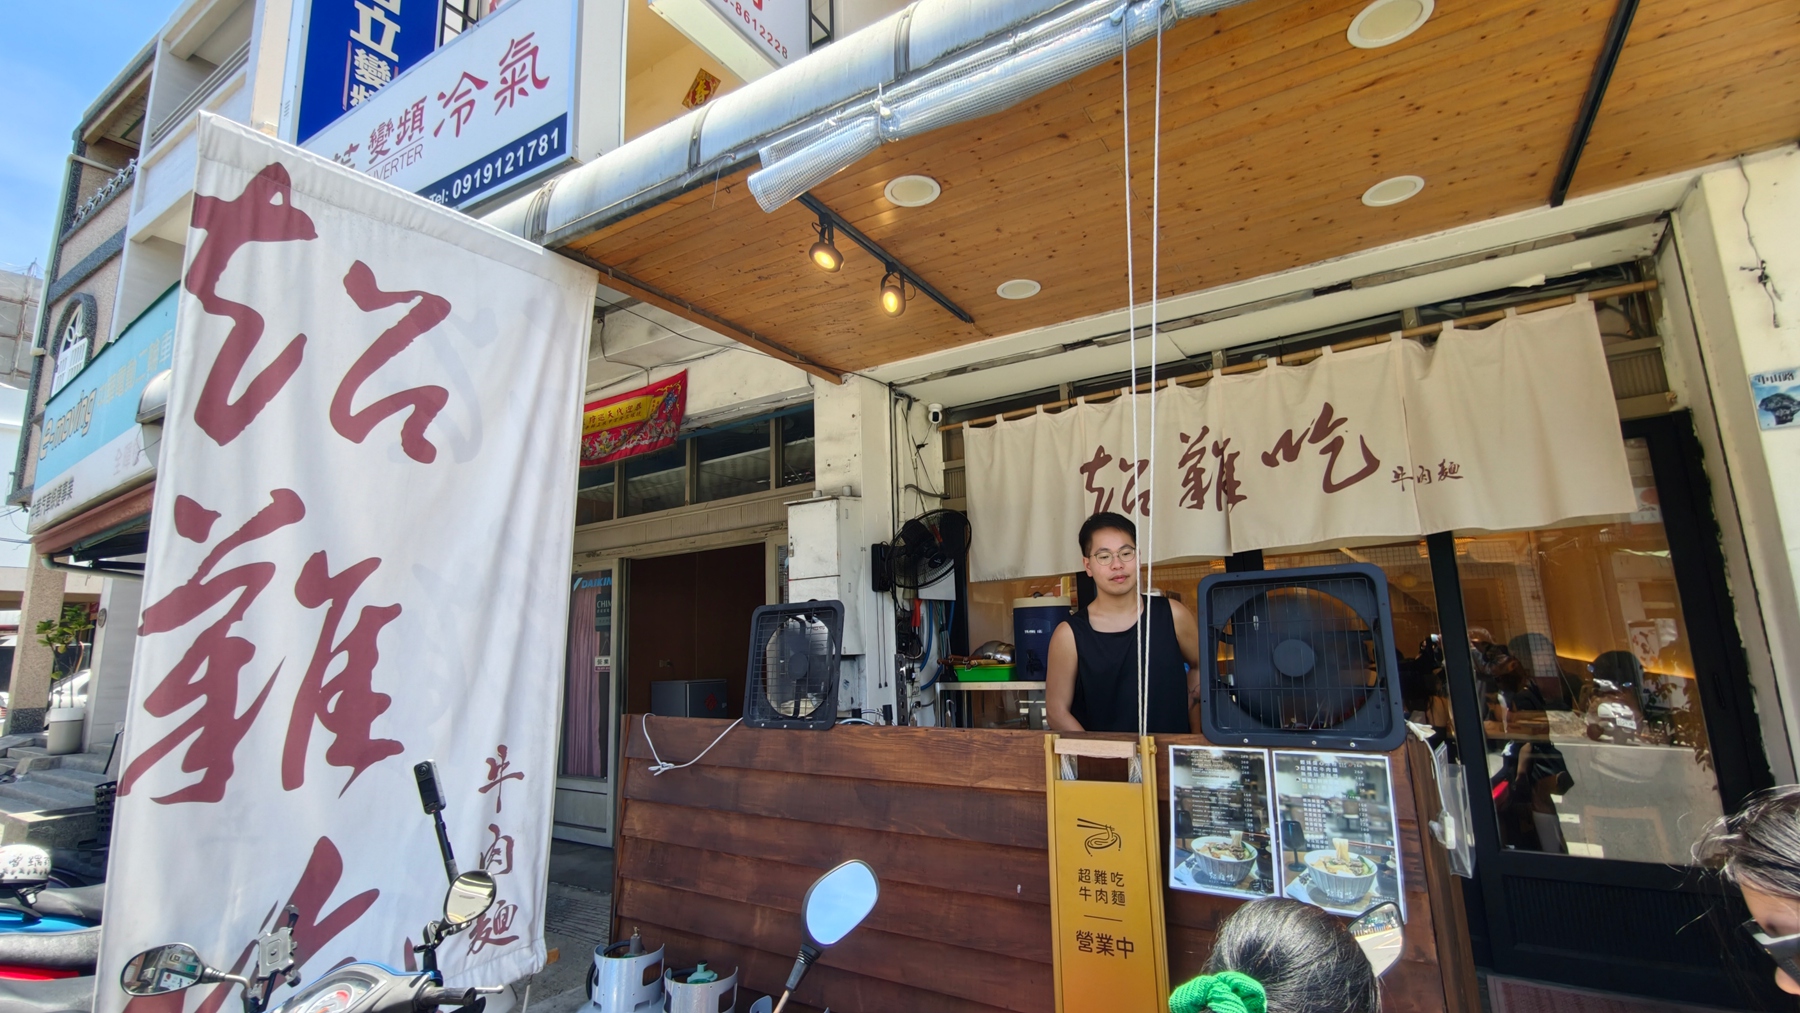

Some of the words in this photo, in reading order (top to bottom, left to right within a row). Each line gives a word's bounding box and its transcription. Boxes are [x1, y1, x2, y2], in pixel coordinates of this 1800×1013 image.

[723, 0, 788, 60] -8612228
[452, 127, 559, 198] 0919121781
[39, 388, 97, 461] e-moving
[467, 744, 525, 957] 牛肉麵
[1078, 868, 1125, 887] 超難吃
[1078, 886, 1126, 906] 牛肉麵
[1075, 930, 1135, 959] 營業中
